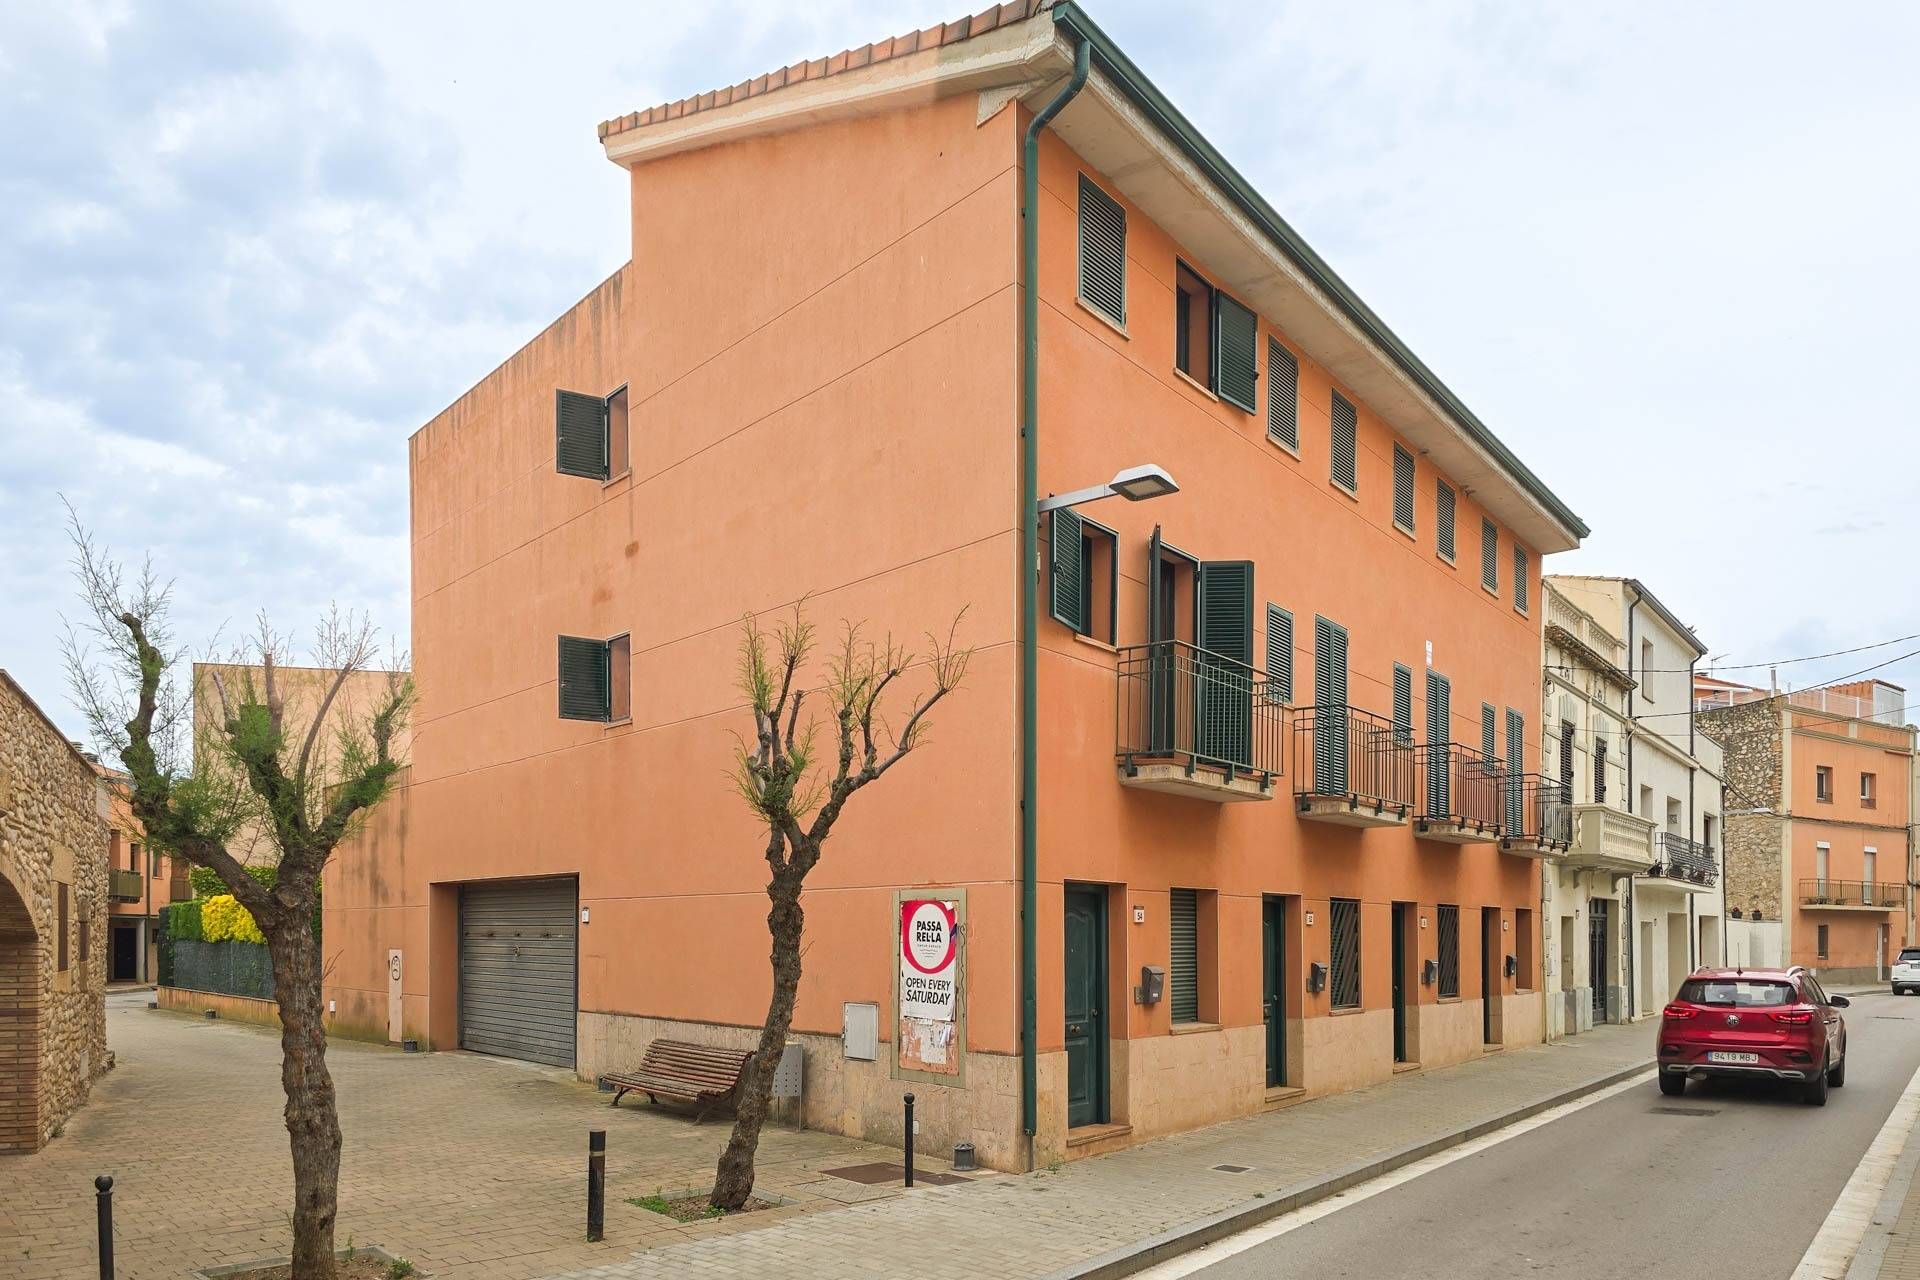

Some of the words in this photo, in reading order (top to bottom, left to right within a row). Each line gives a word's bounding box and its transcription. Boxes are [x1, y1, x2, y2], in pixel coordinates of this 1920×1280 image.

[916, 920, 942, 931] PASSA
[906, 977, 926, 988] OPEN
[928, 979, 951, 990] EVERY
[906, 989, 951, 1005] SATURDAY
[1714, 1052, 1737, 1061] 9419
[1739, 1054, 1757, 1062] MBJ
